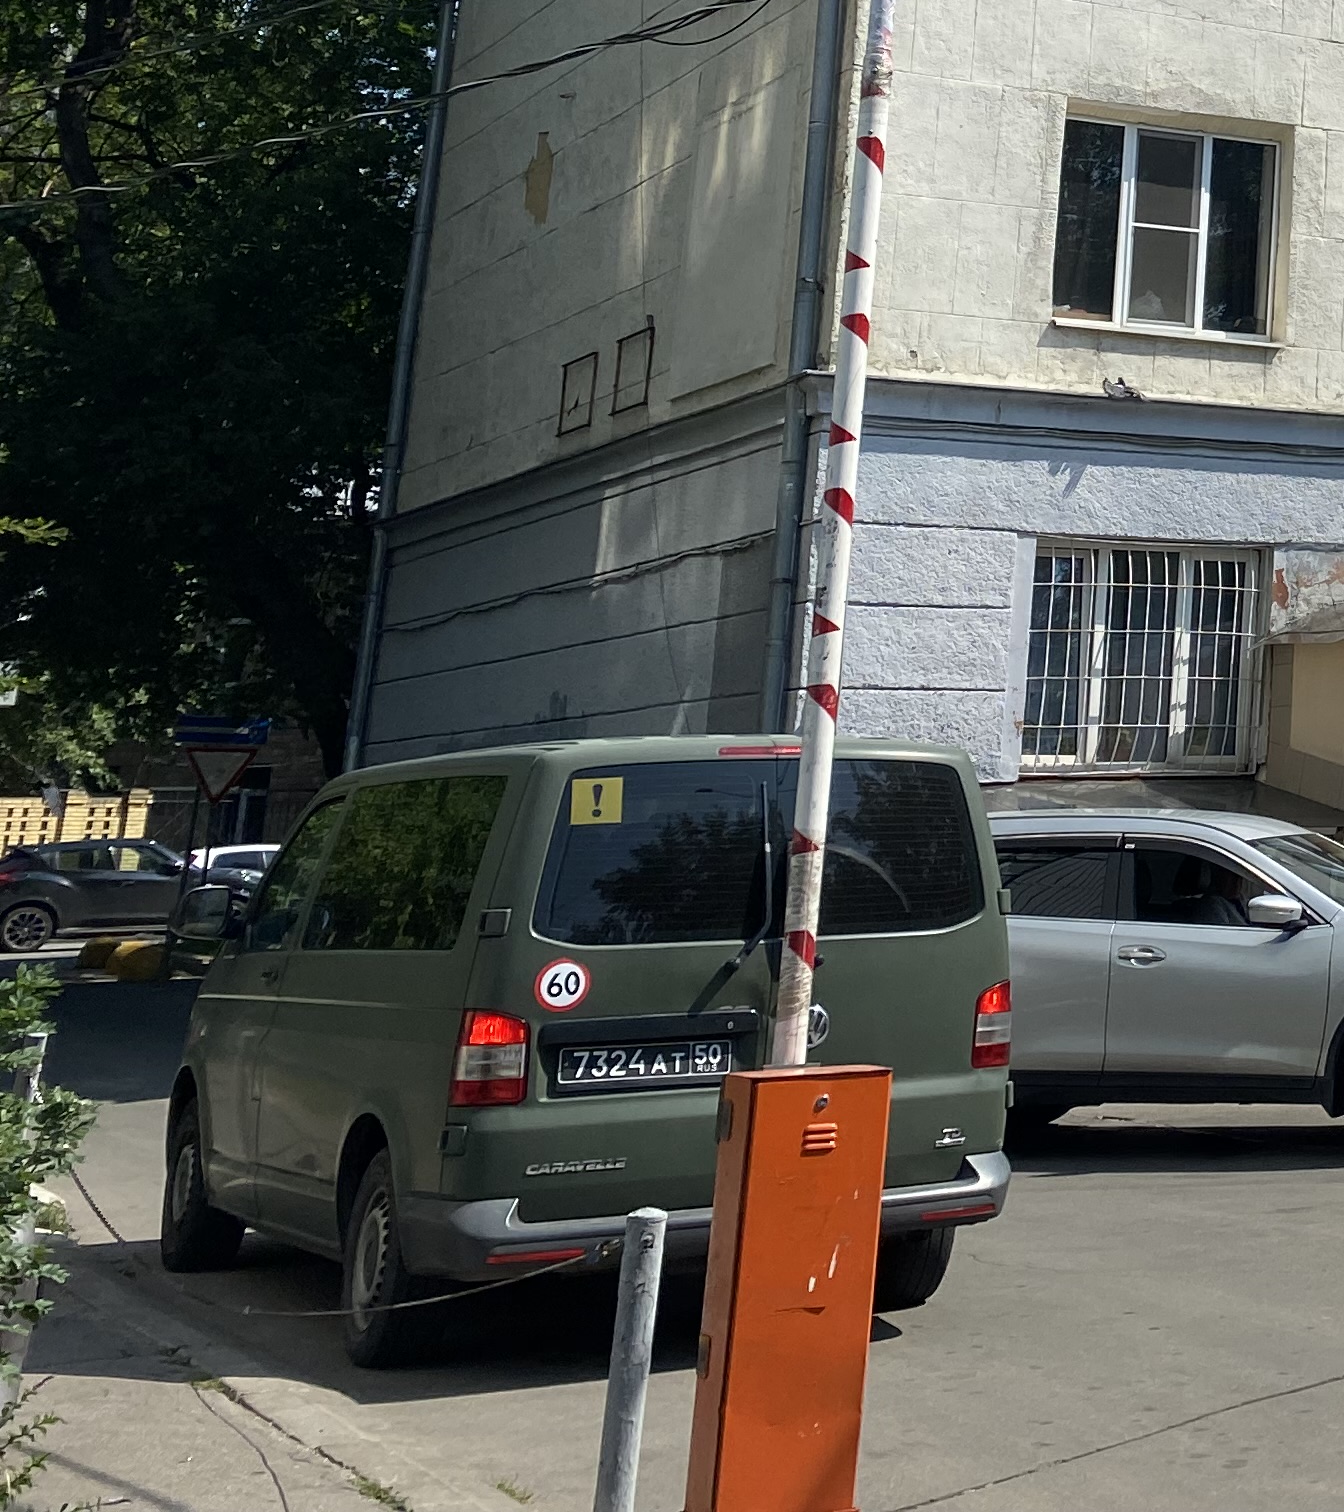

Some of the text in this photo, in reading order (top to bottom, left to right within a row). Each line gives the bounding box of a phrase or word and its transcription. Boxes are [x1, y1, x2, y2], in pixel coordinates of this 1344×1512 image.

[546, 971, 581, 998] 60
[694, 1044, 722, 1065] 50
[696, 1063, 718, 1073] RUS
[525, 1157, 628, 1177] CARAVELLE
